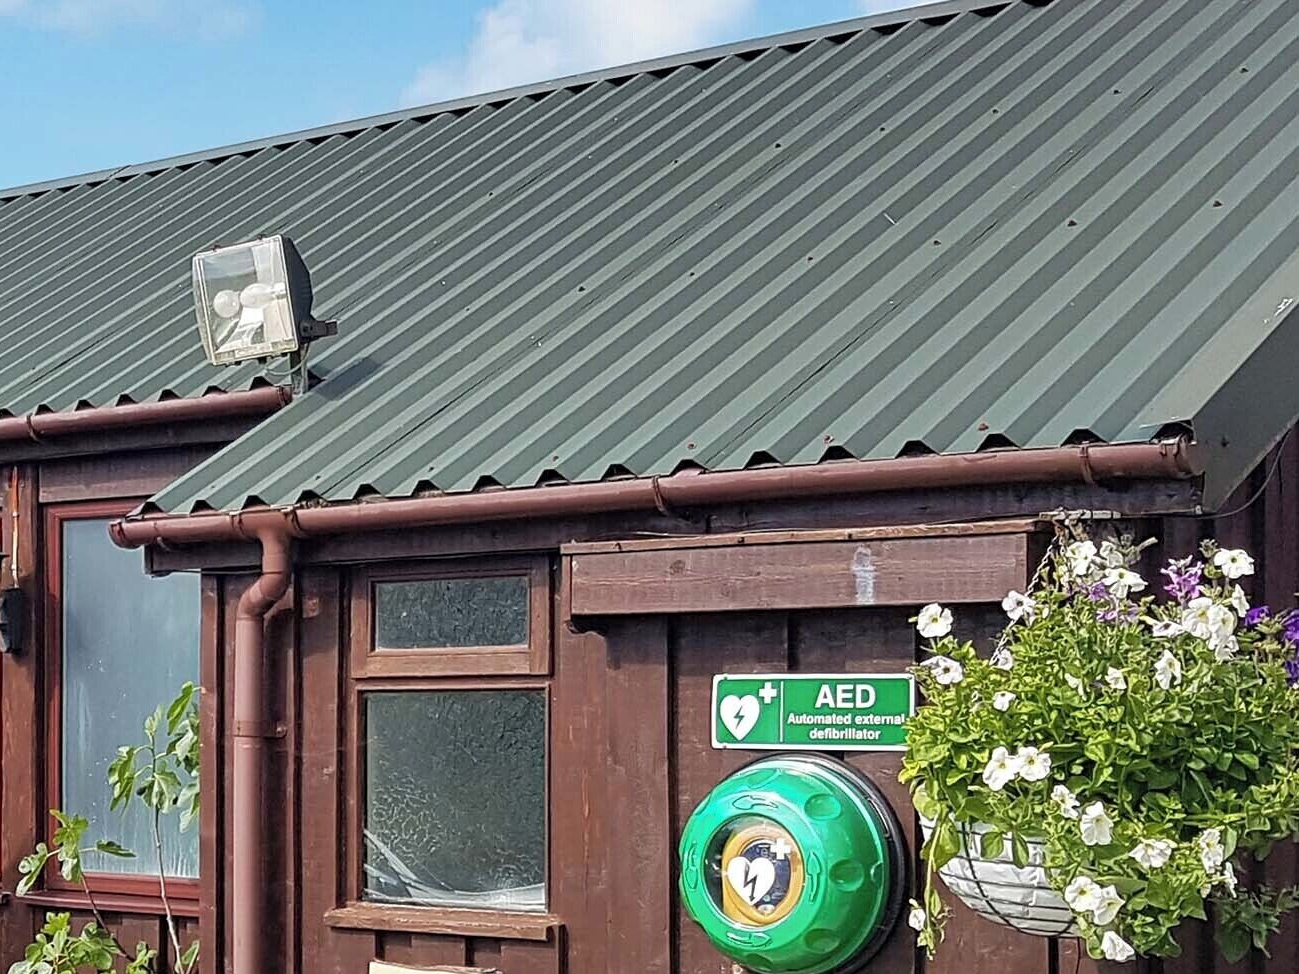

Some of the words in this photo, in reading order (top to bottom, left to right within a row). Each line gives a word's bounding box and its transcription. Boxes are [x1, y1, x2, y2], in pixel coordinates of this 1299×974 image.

[814, 684, 876, 709] AED
[787, 713, 850, 725] Automated
[855, 714, 905, 725] external
[809, 728, 881, 740] defibrillator
